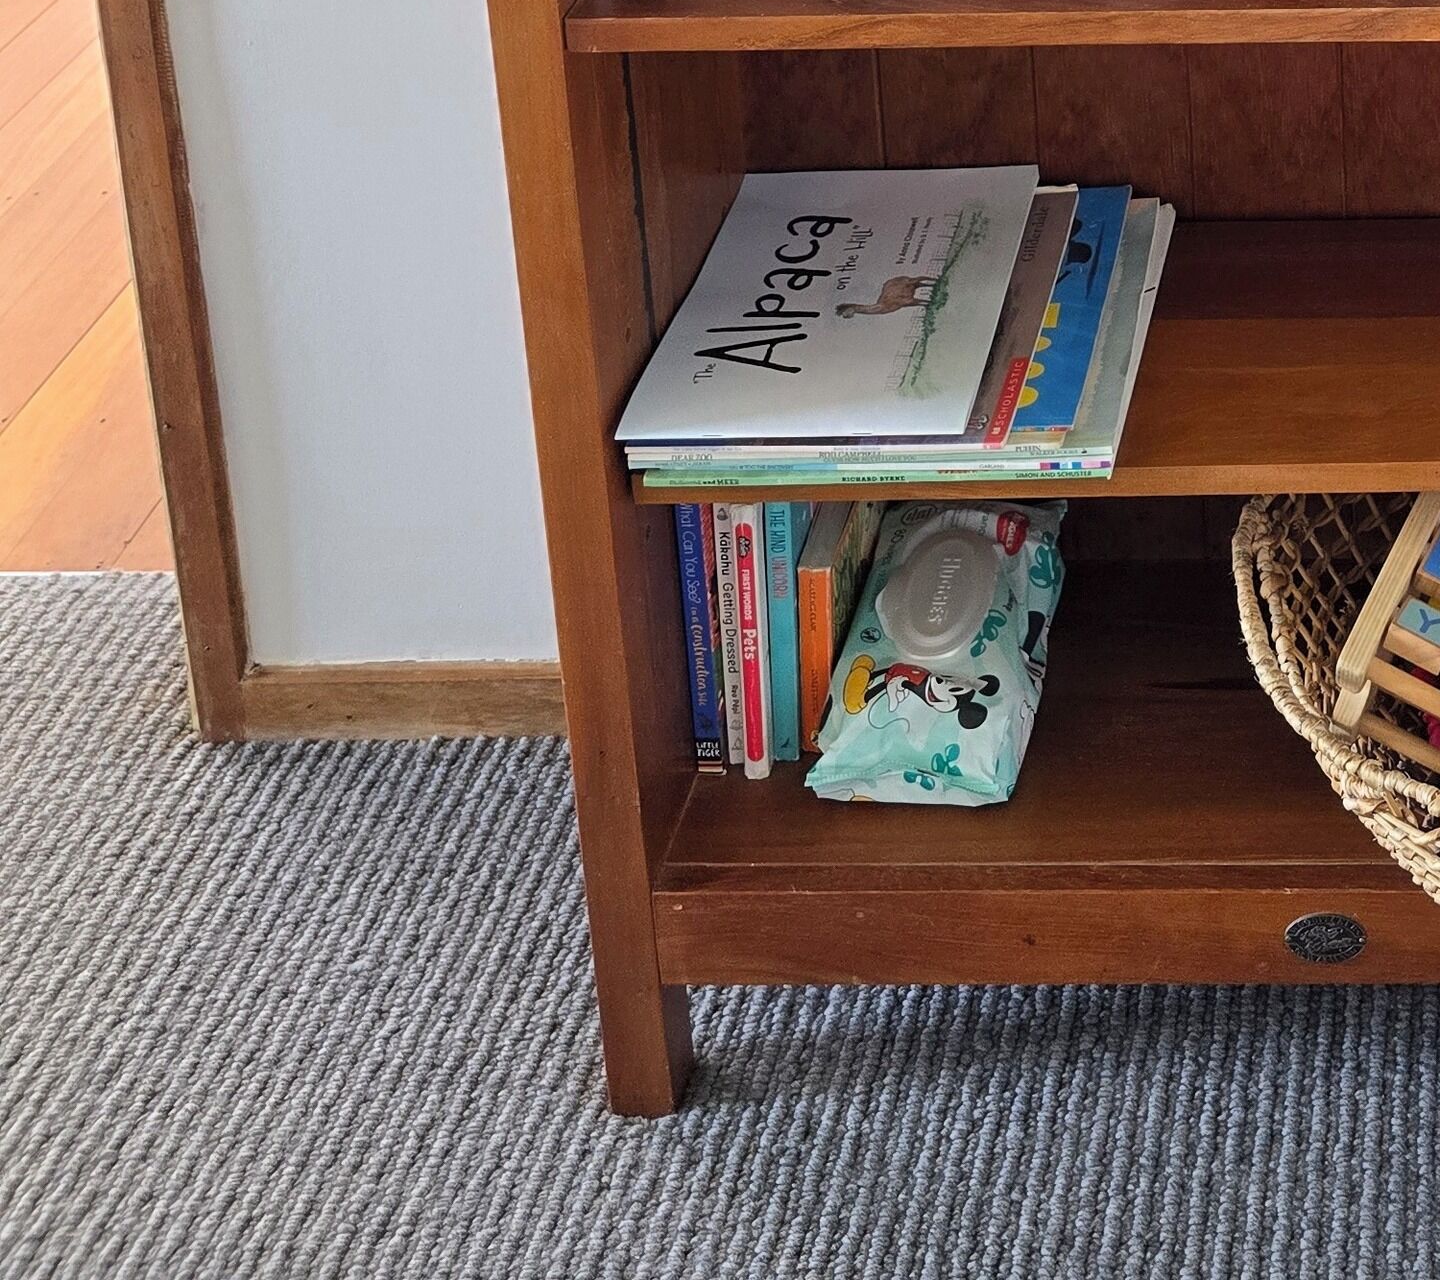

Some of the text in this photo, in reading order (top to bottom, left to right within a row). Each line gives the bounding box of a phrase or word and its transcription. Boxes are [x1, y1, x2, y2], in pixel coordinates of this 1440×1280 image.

[1022, 206, 1049, 263] Gilderdale
[835, 255, 859, 276] the
[694, 215, 852, 374] Alpaca
[836, 276, 851, 290] on
[997, 361, 1024, 425] SCHOLASTIC
[769, 510, 785, 528] THE
[682, 531, 696, 554] Can
[685, 557, 699, 577] You
[771, 556, 789, 599] UNICORN
[687, 580, 701, 603] See?
[719, 531, 739, 673] Kākahu Getting Dressed
[742, 569, 752, 620] FIRST WORDS
[691, 624, 707, 689] Construction
[743, 628, 756, 660] Pets
[697, 749, 720, 757] TIGER
